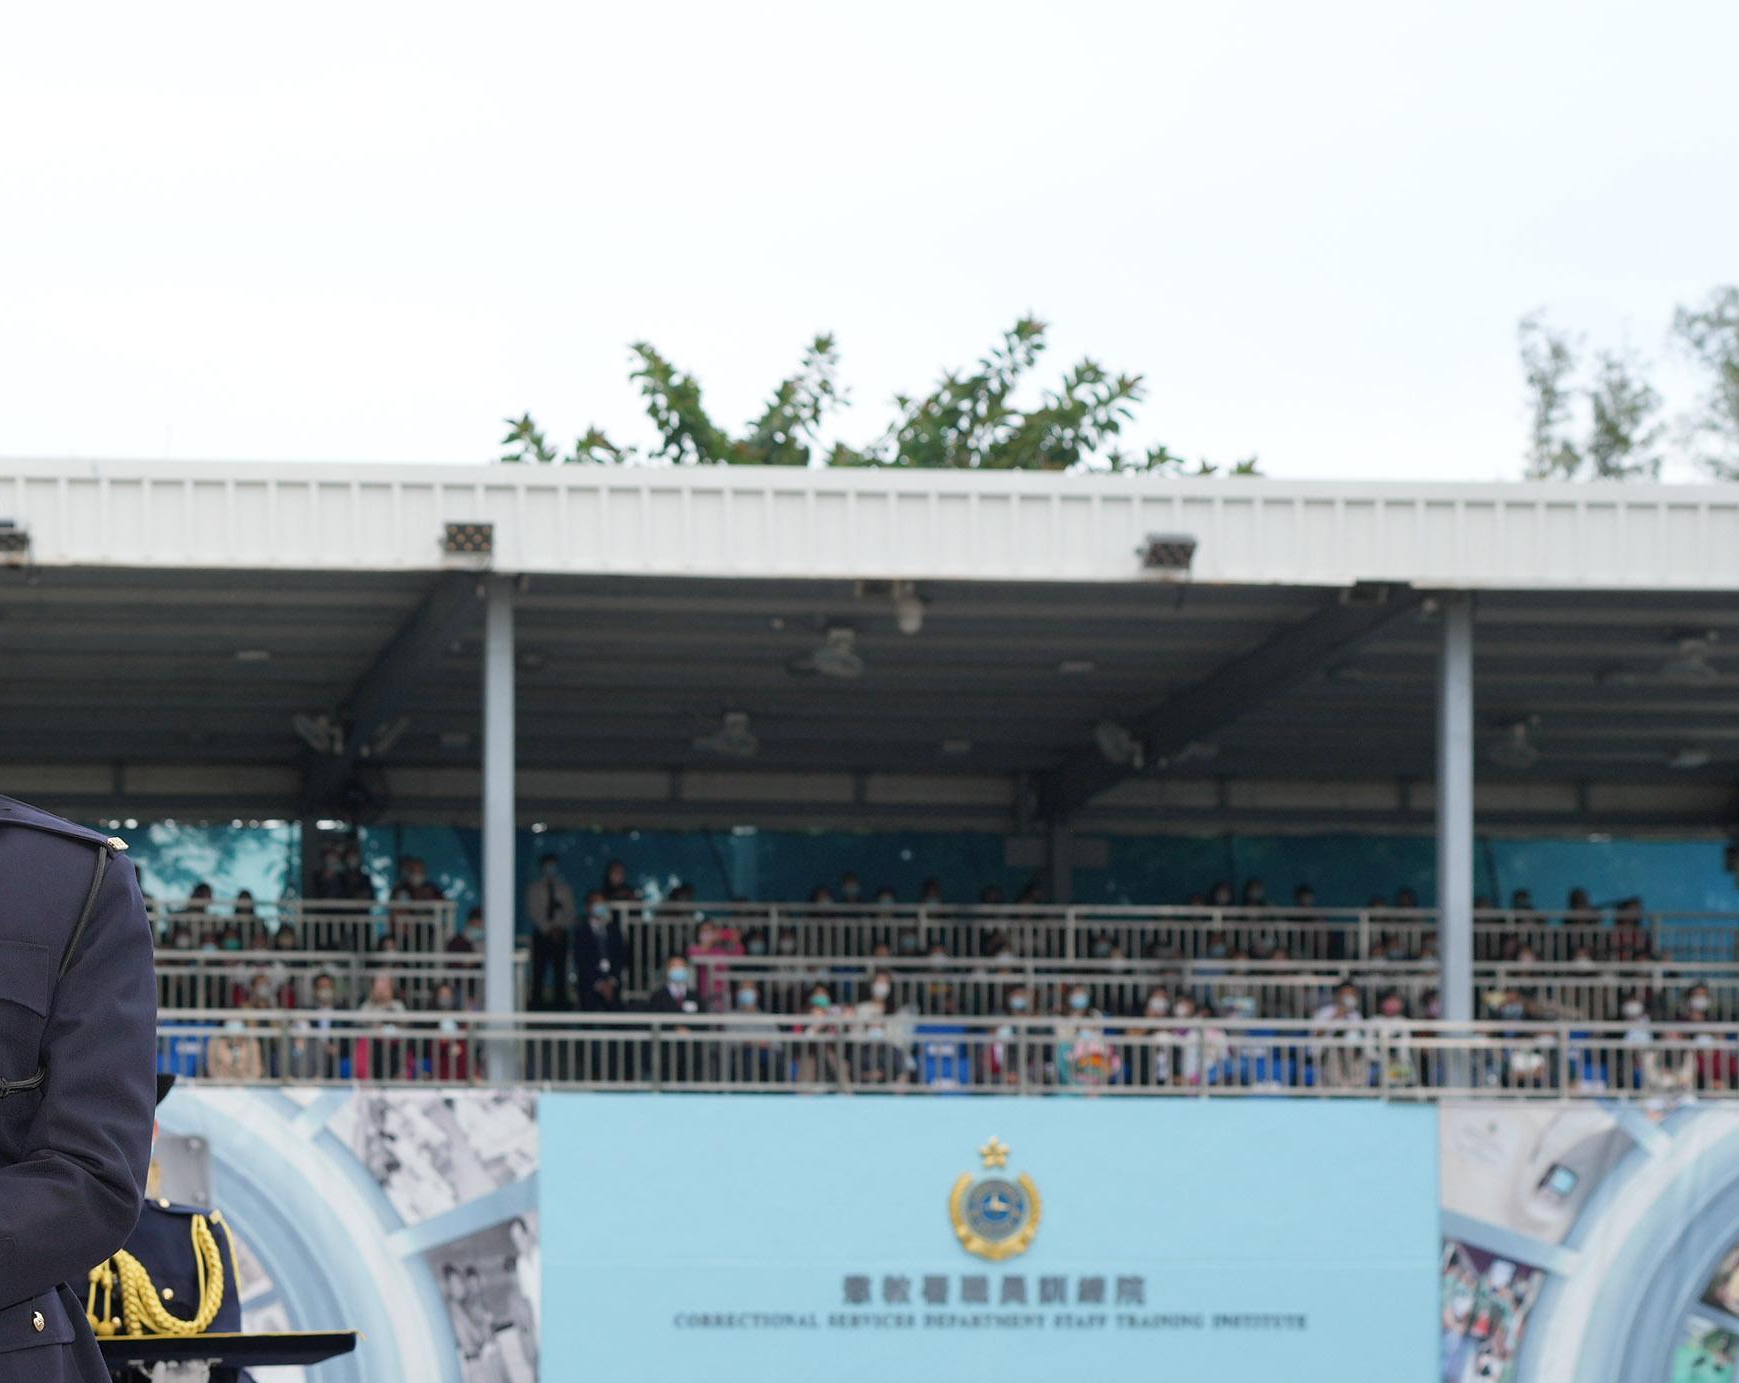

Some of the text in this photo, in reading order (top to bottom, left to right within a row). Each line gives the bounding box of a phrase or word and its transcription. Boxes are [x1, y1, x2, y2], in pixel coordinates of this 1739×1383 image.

[672, 1313, 1308, 1330] CORRECTIONAL SERVICES DEPARTMENT STAFF TRAINING INSTITUTE
